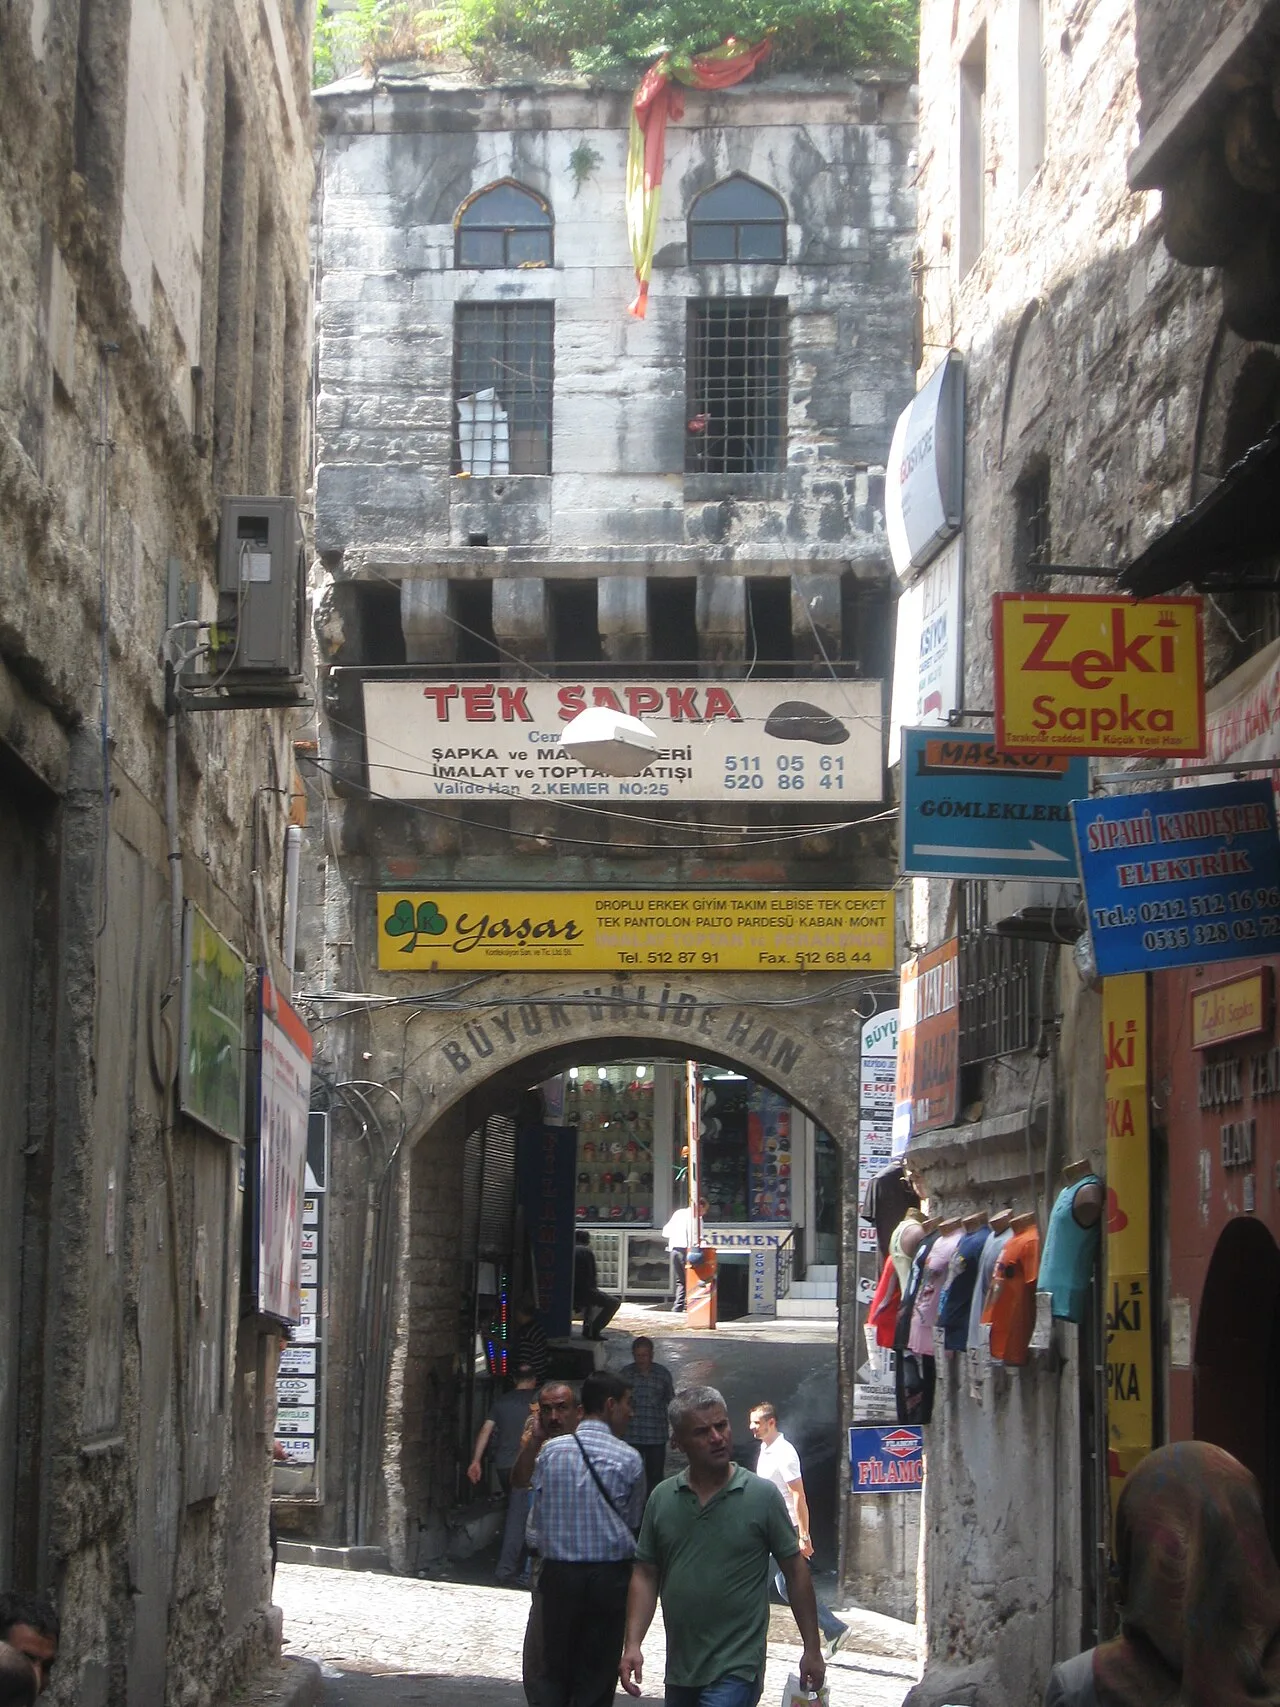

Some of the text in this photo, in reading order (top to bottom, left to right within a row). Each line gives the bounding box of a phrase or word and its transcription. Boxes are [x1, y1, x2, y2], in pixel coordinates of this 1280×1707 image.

[1020, 607, 1176, 690] Zeki
[424, 684, 534, 722] TEK
[432, 748, 498, 763] ŞAPKA
[509, 751, 528, 760] ve
[724, 755, 845, 772] 511 05 61
[433, 766, 508, 778] İMALAT
[515, 769, 535, 778] ve
[538, 767, 612, 778] TOPTA
[724, 774, 845, 790] 520 86 41
[434, 782, 669, 796] Valide Han 2.KEMER NO:25
[1087, 802, 1271, 851] SİPAHİ KARDEŞLER
[1117, 846, 1253, 888] ELEKTRİK
[595, 897, 886, 911] DROPLU ERKEK GİYİM TAKIM ELBİSE TEK CEKET
[1139, 897, 1186, 923] 0212
[1190, 891, 1226, 917] 512
[1228, 888, 1252, 912] 16
[1254, 885, 1280, 909] 96
[597, 915, 886, 928] TEK PANTOLON PALTO PARDESÜ KABAN MONT
[1143, 913, 1280, 951] 0535 328 02 72
[617, 952, 872, 963] Tel. 512 87 91 Fax. 512 68 44
[725, 1011, 803, 1075] HAN
[1220, 1118, 1255, 1167] HAN
